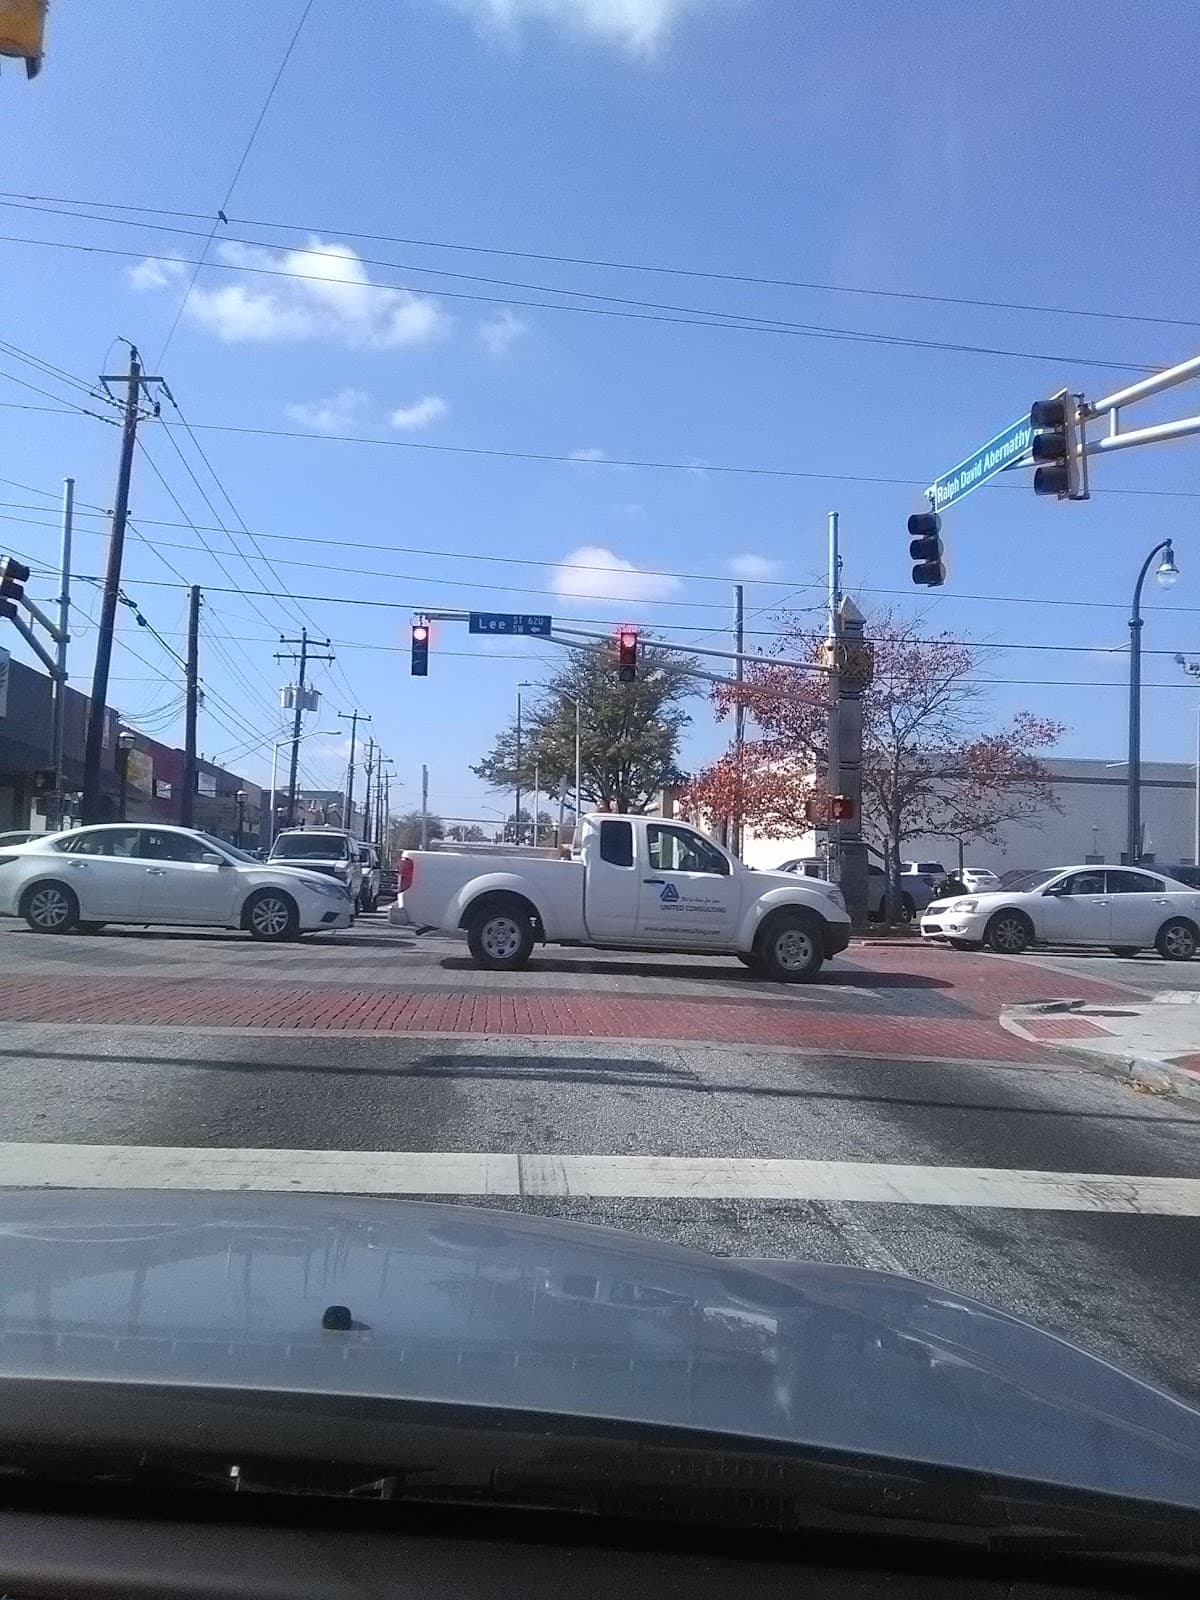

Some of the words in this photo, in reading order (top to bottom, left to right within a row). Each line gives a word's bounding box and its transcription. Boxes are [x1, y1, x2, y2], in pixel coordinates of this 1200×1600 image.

[937, 477, 960, 503] Ralph
[960, 459, 982, 488] David
[983, 427, 1032, 472] Abernathy
[479, 618, 506, 629] Lee
[512, 616, 523, 624] ST
[528, 617, 544, 625] 620
[512, 625, 523, 633] SW
[686, 905, 726, 913] CONSULTING
